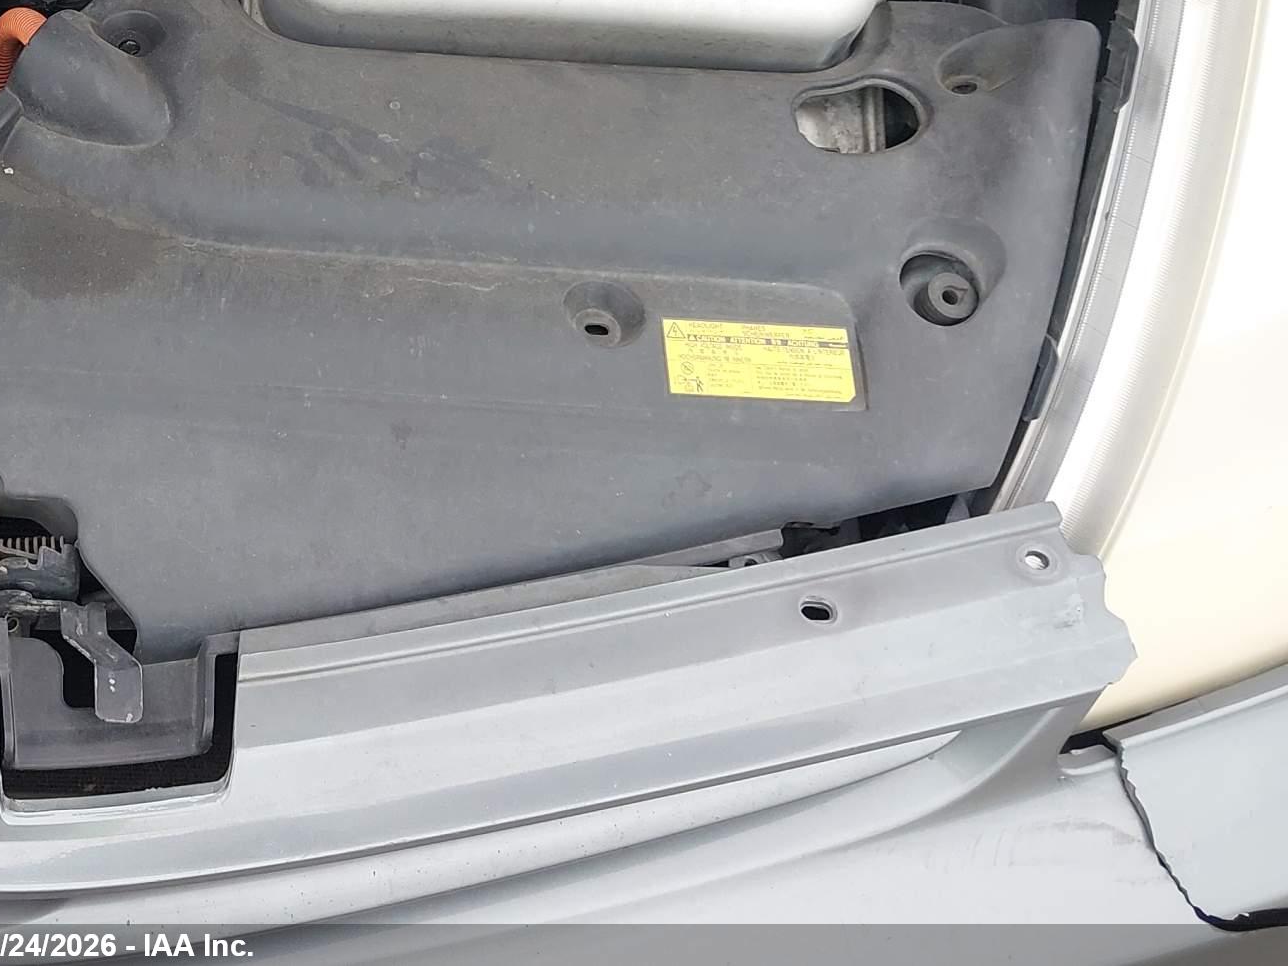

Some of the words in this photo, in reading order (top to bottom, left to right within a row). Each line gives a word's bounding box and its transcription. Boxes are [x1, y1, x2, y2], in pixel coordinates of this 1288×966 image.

[696, 334, 726, 343] CAUTION
[730, 336, 765, 346] ATTENTION
[787, 339, 819, 349] ACHTUNG
